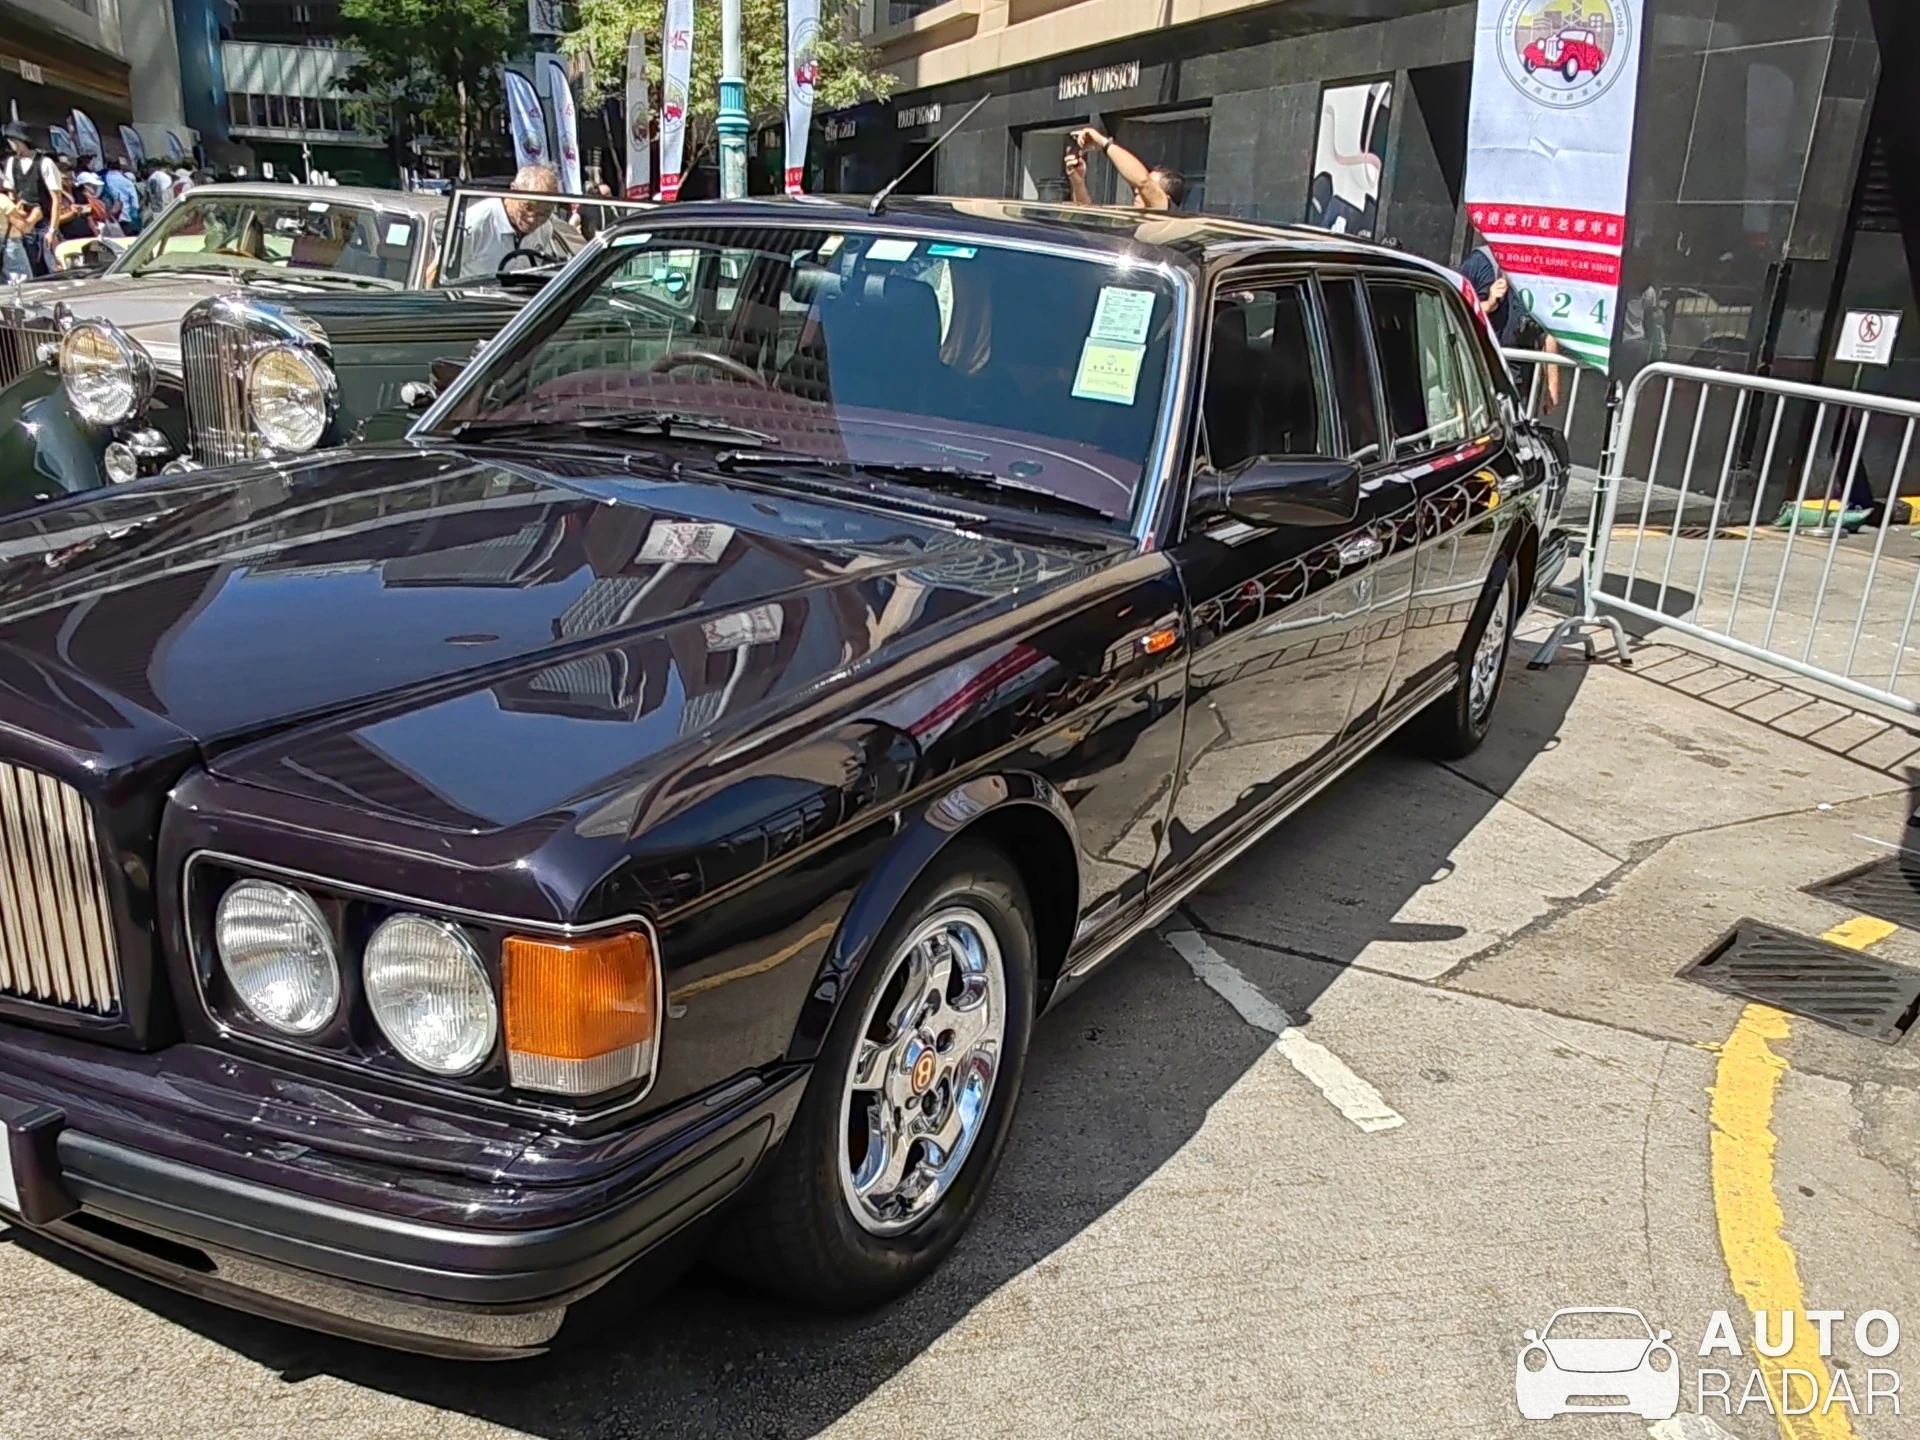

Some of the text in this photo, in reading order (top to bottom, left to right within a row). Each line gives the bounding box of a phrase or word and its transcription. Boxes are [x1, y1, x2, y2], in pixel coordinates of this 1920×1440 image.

[1614, 5, 1625, 36] KONG
[1506, 253, 1532, 264] ROAD
[1533, 256, 1569, 267] CLASSIC
[1571, 260, 1589, 269] CAR
